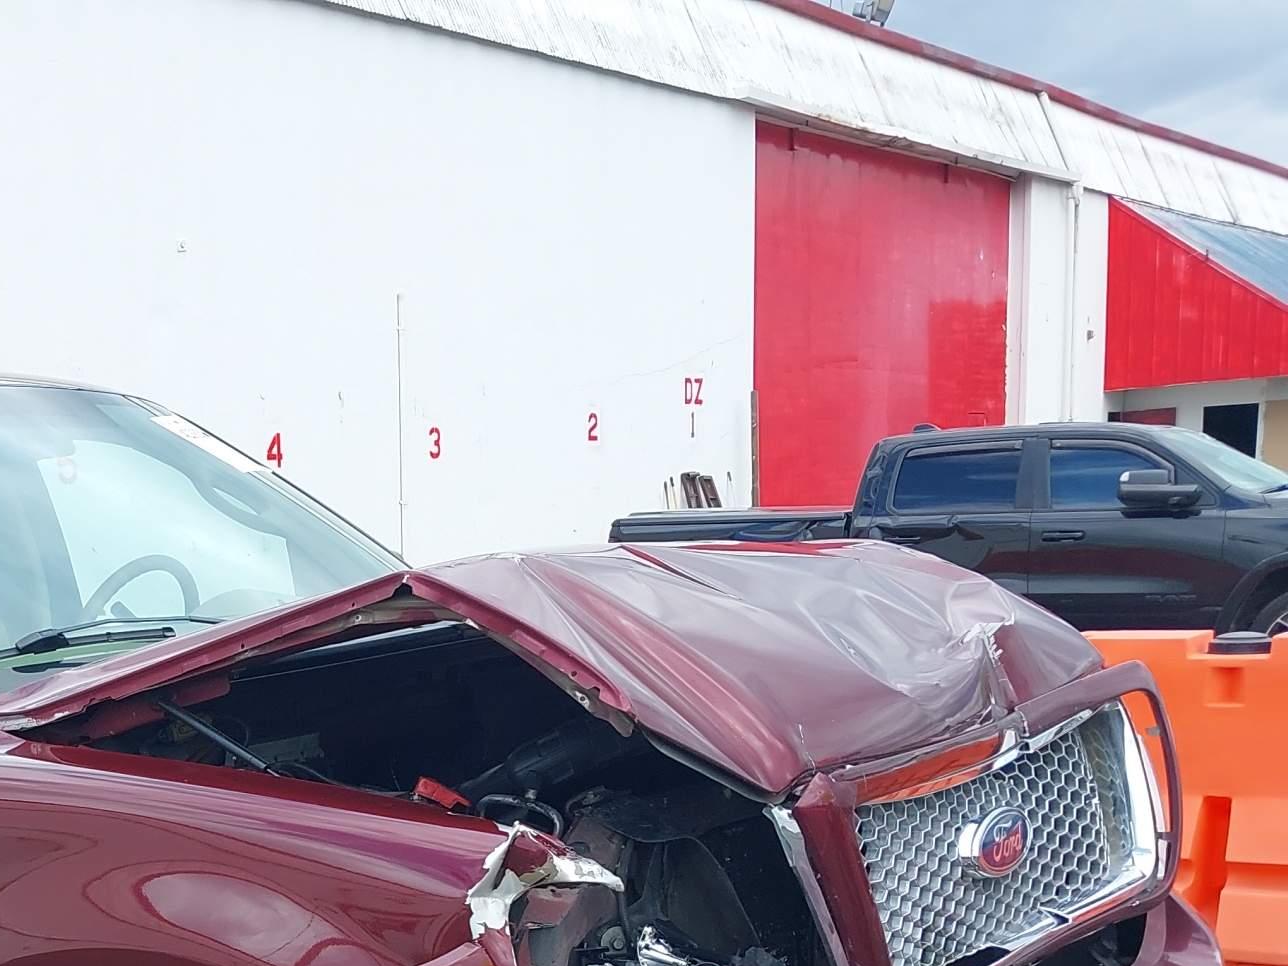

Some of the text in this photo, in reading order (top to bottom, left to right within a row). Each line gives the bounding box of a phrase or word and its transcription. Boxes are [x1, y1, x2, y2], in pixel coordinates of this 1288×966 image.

[685, 377, 703, 405] DZ
[428, 426, 441, 459] 3
[587, 413, 598, 442] 2
[266, 432, 283, 468] 4
[993, 819, 1024, 863] Ford
